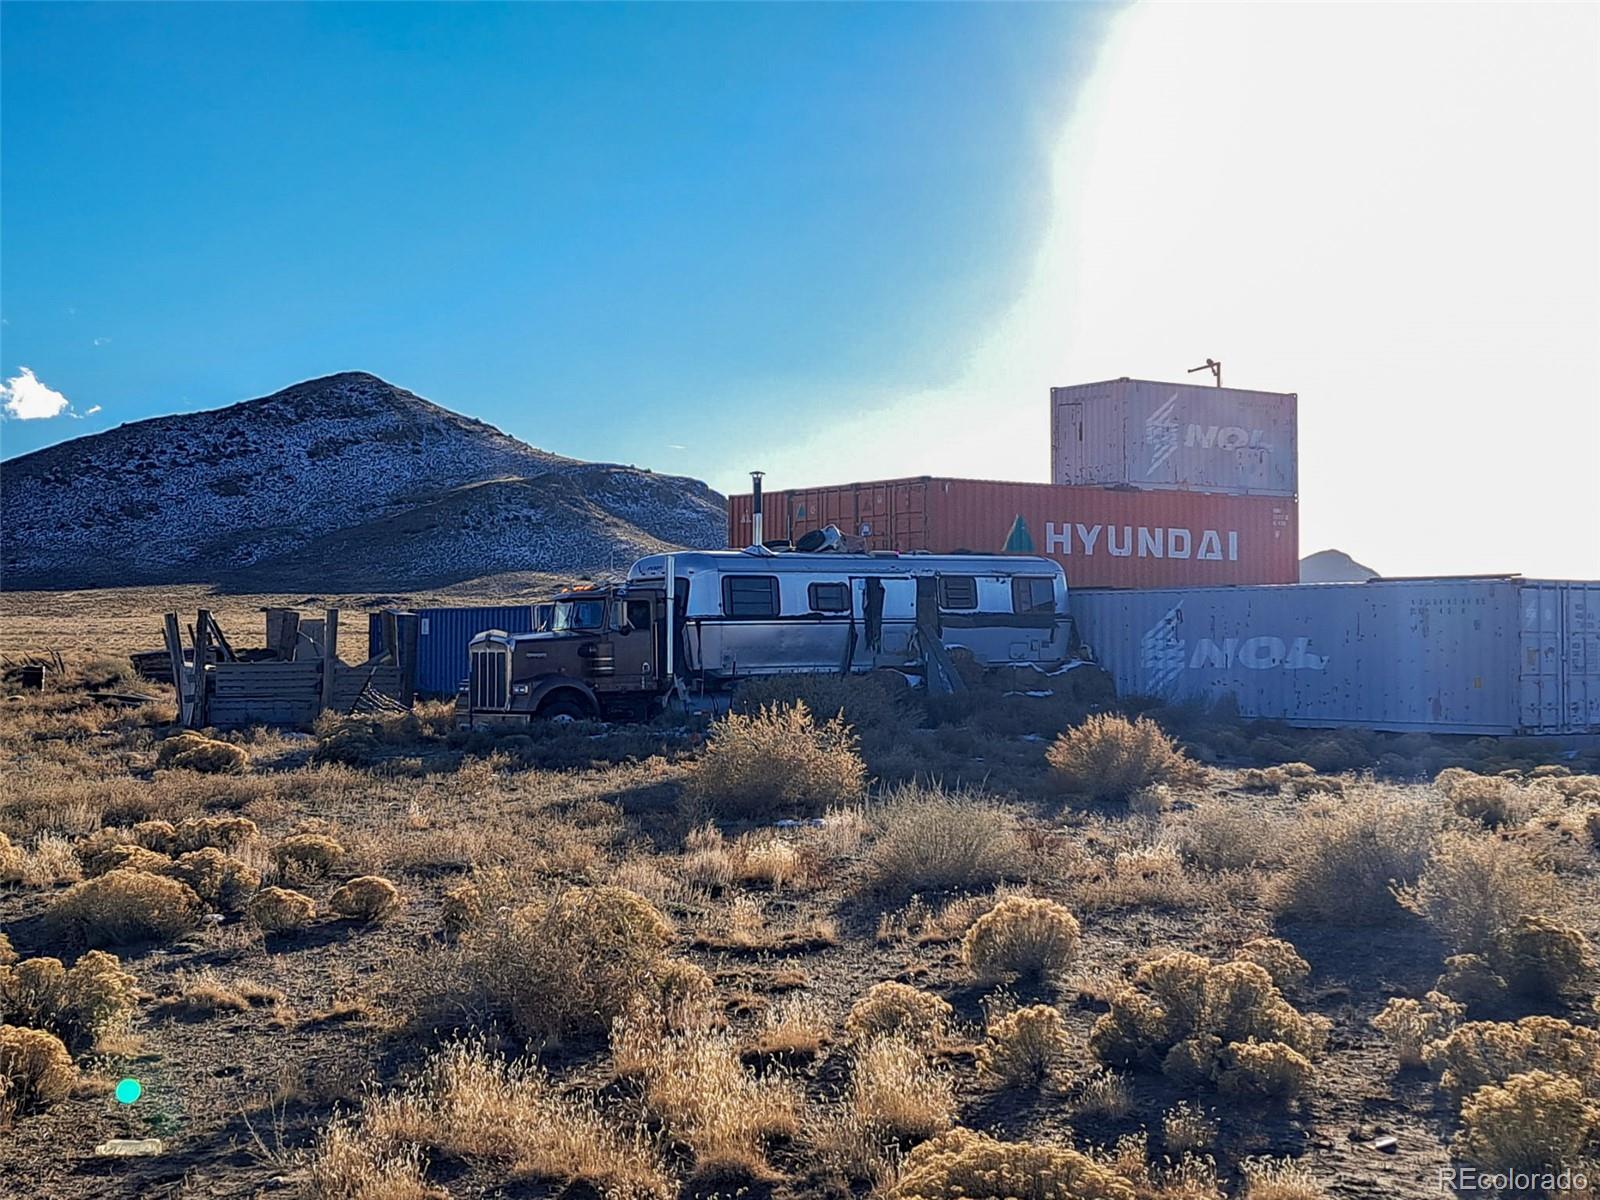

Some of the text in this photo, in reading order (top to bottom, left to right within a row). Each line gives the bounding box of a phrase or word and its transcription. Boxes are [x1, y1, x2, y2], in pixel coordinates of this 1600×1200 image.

[1183, 423, 1273, 453] NOL
[1045, 522, 1238, 561] HYUNDAI
[1189, 636, 1330, 670] NOL
